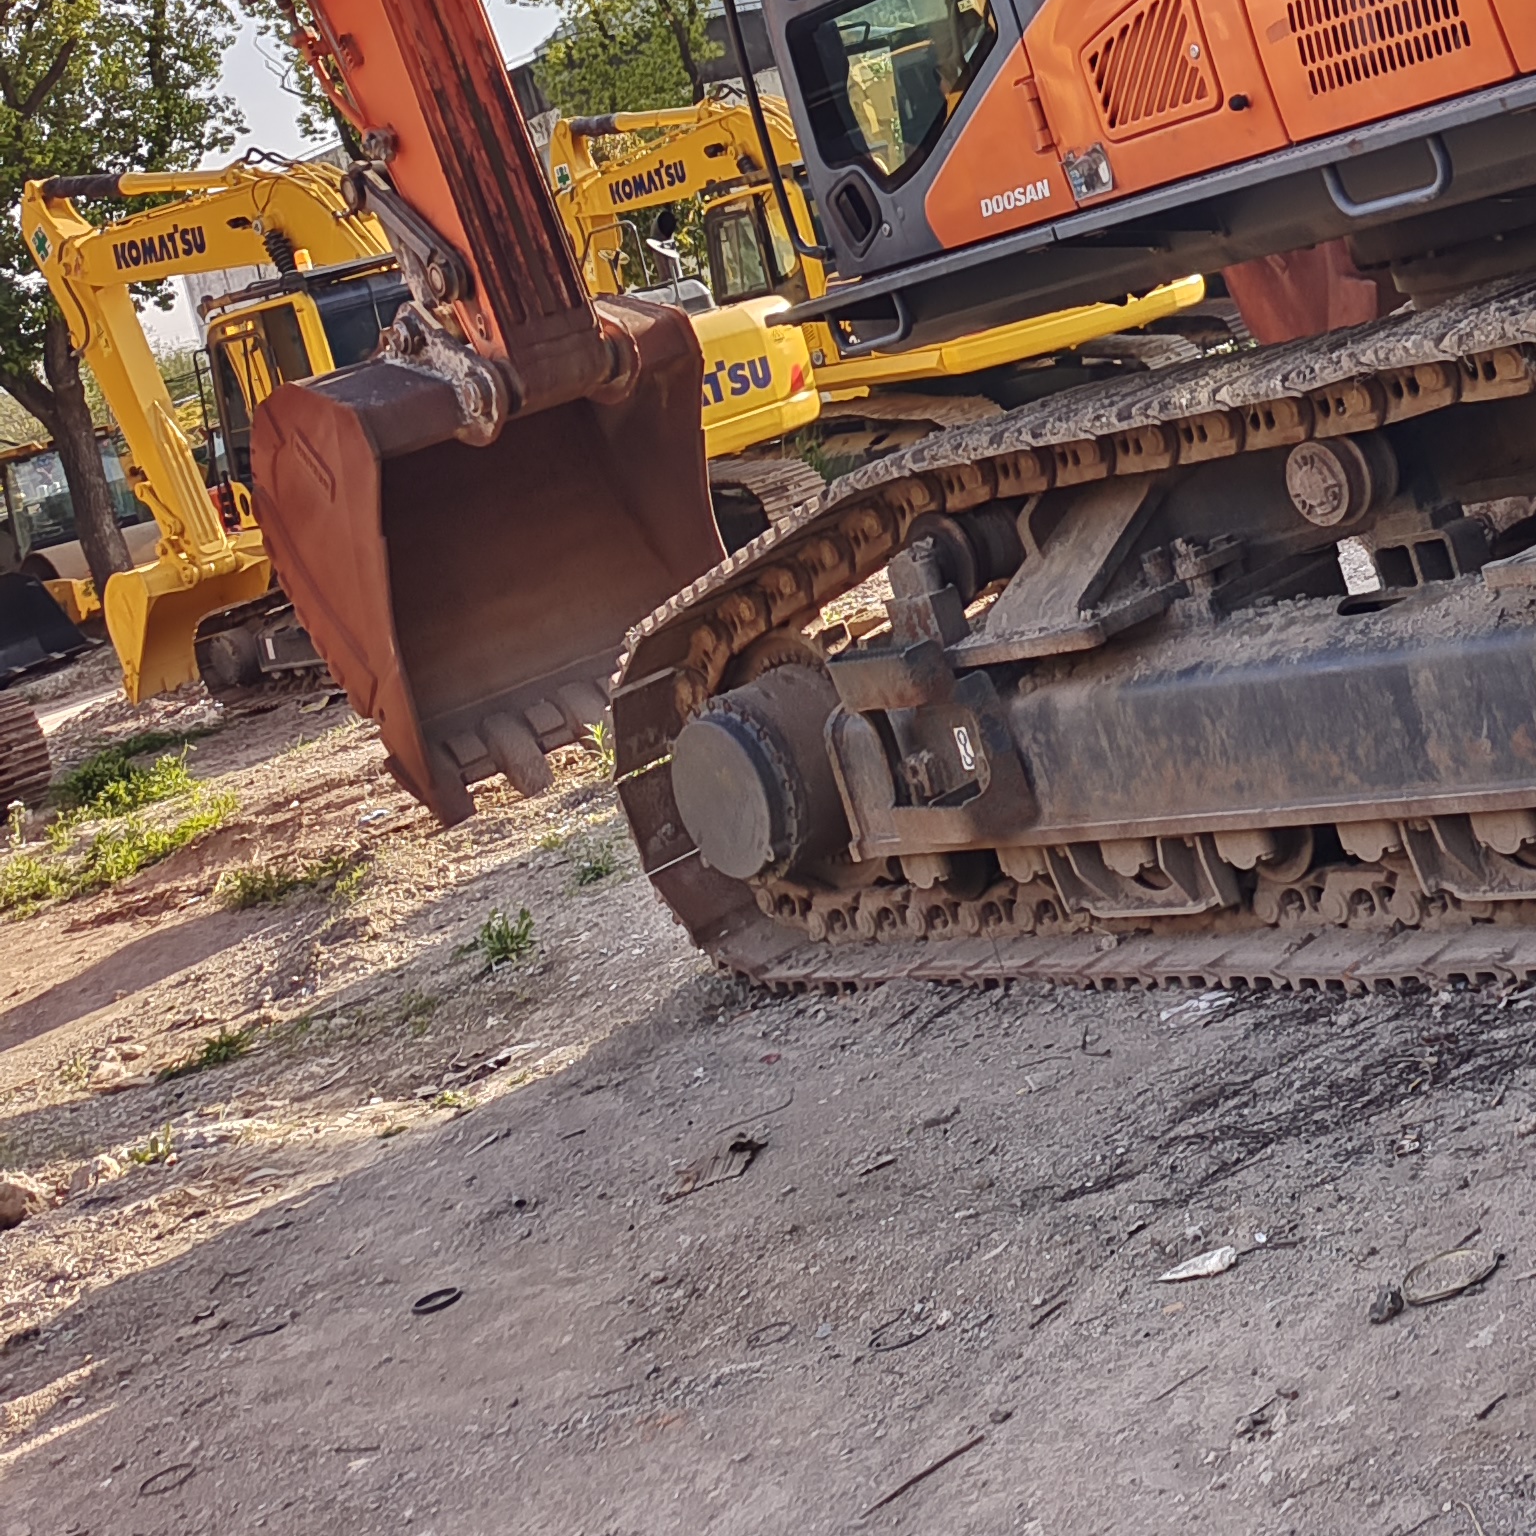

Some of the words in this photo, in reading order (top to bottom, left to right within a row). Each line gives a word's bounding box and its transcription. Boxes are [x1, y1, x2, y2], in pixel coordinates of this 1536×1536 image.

[609, 159, 687, 206] KOMATSU
[980, 178, 1051, 218] DOOSAN
[112, 224, 207, 270] KOMATSU
